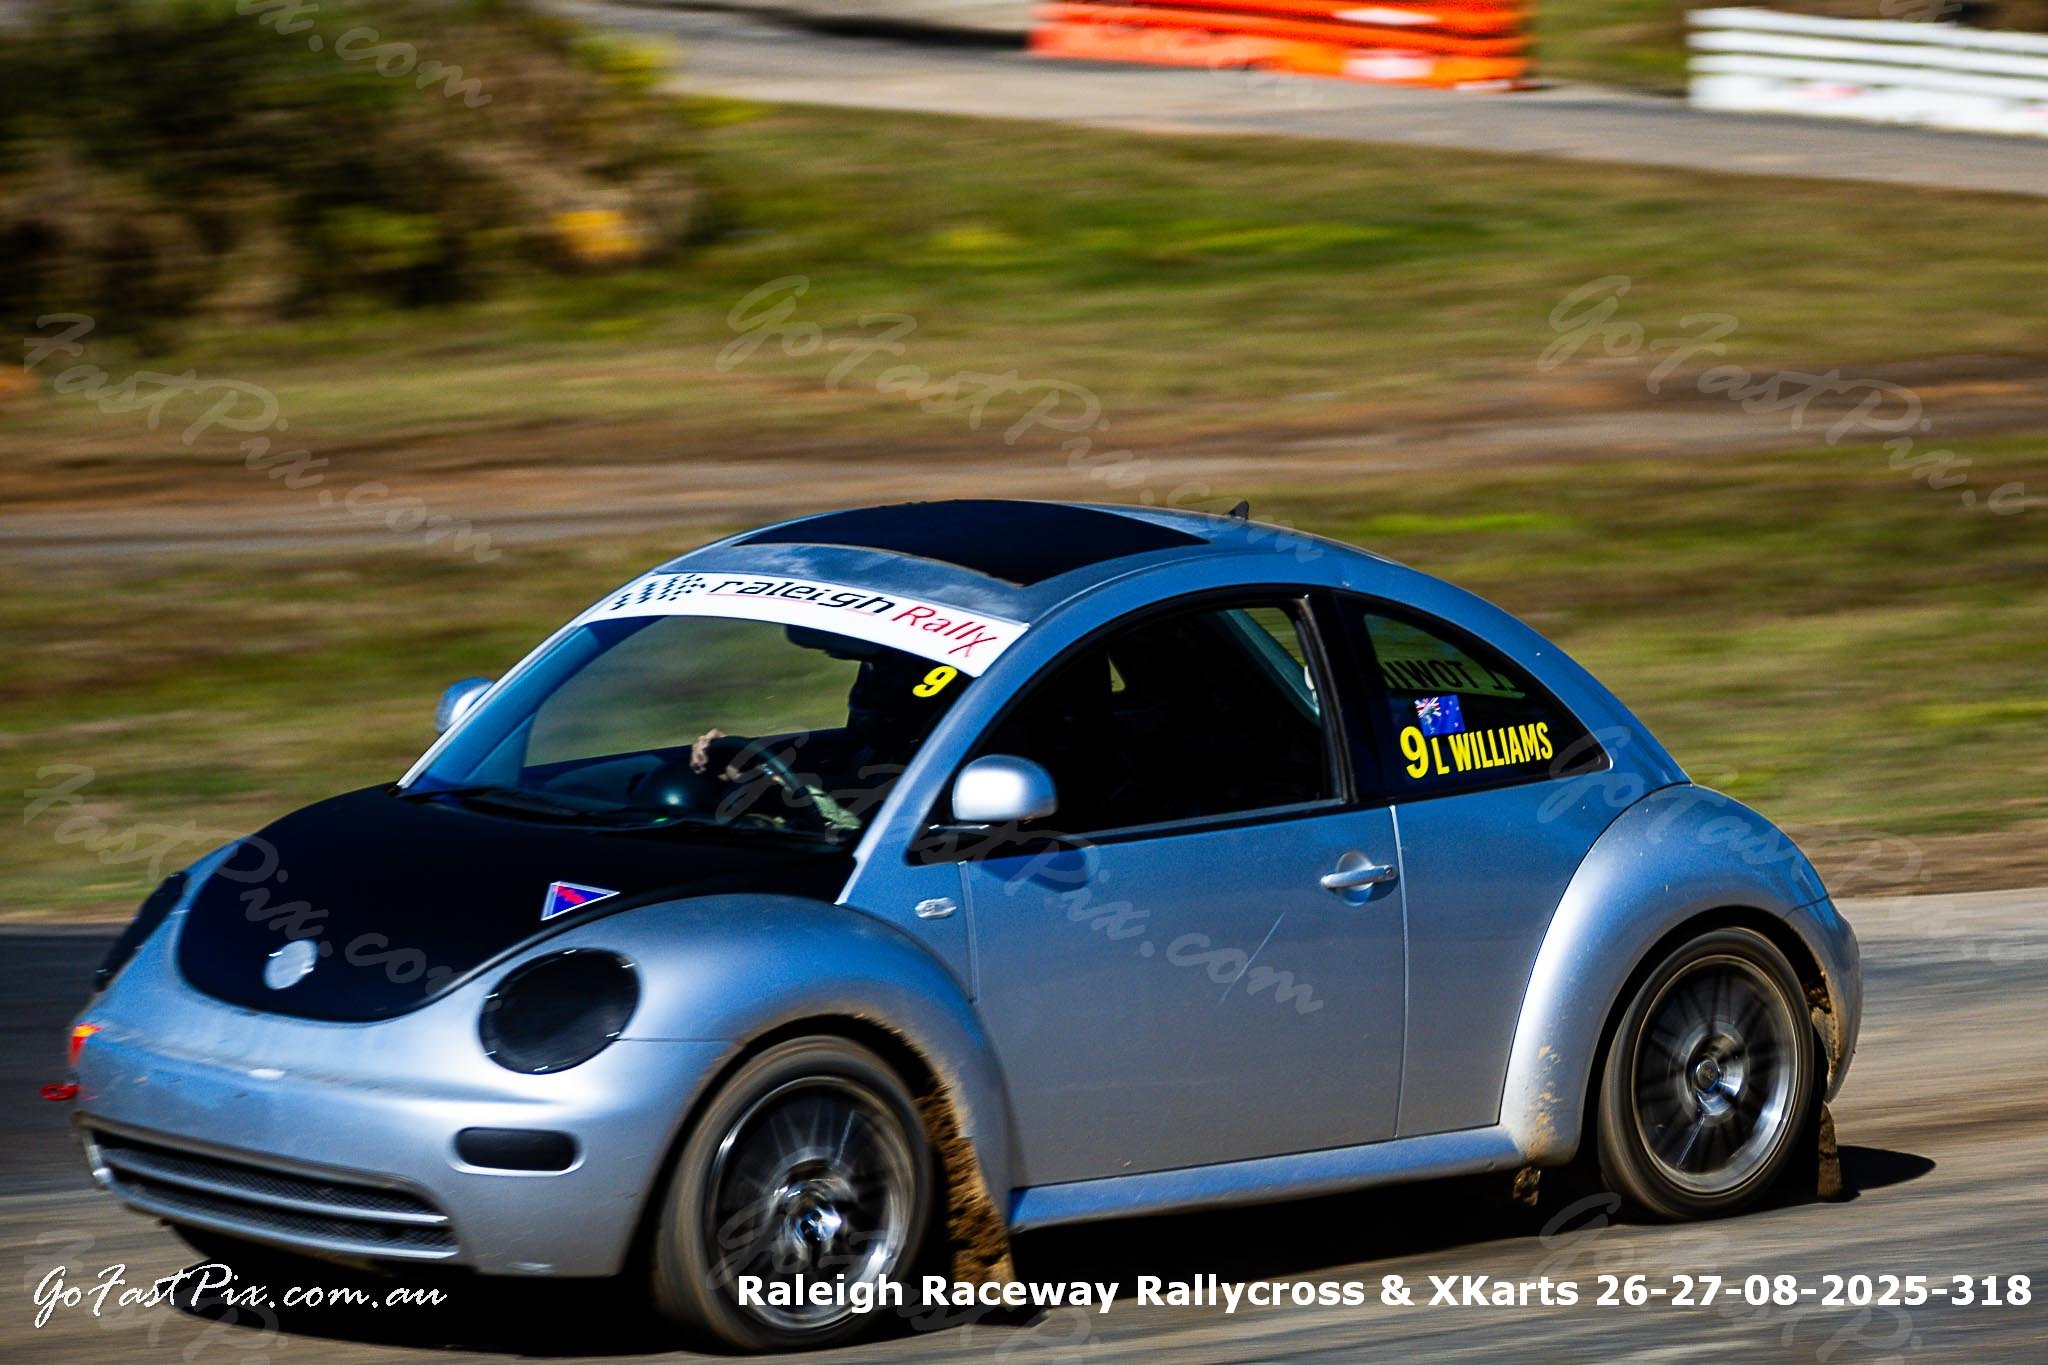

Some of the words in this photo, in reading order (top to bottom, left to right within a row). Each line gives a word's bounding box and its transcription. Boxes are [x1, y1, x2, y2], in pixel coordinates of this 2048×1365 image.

[709, 580, 896, 614] raleigh
[913, 666, 957, 698] 9
[1400, 726, 1429, 779] 9
[1431, 737, 1450, 775] L
[1448, 721, 1553, 772] WILLIAMS
